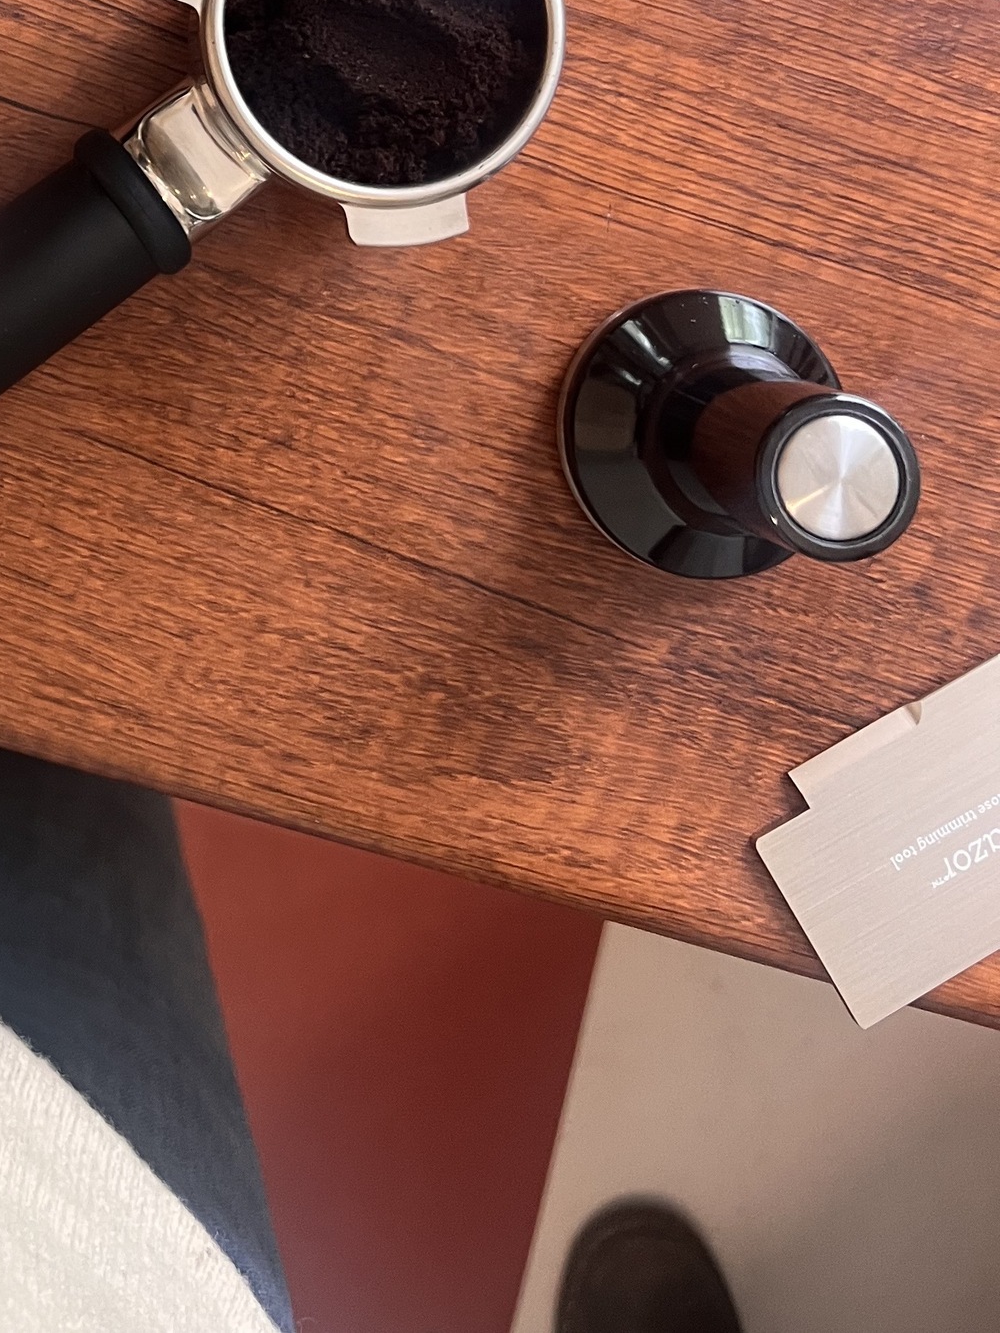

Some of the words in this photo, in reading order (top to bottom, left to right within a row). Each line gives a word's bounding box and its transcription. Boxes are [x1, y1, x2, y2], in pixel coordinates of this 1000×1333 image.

[977, 793, 1000, 814] ose
[916, 809, 978, 851] trimming
[889, 845, 918, 871] tool
